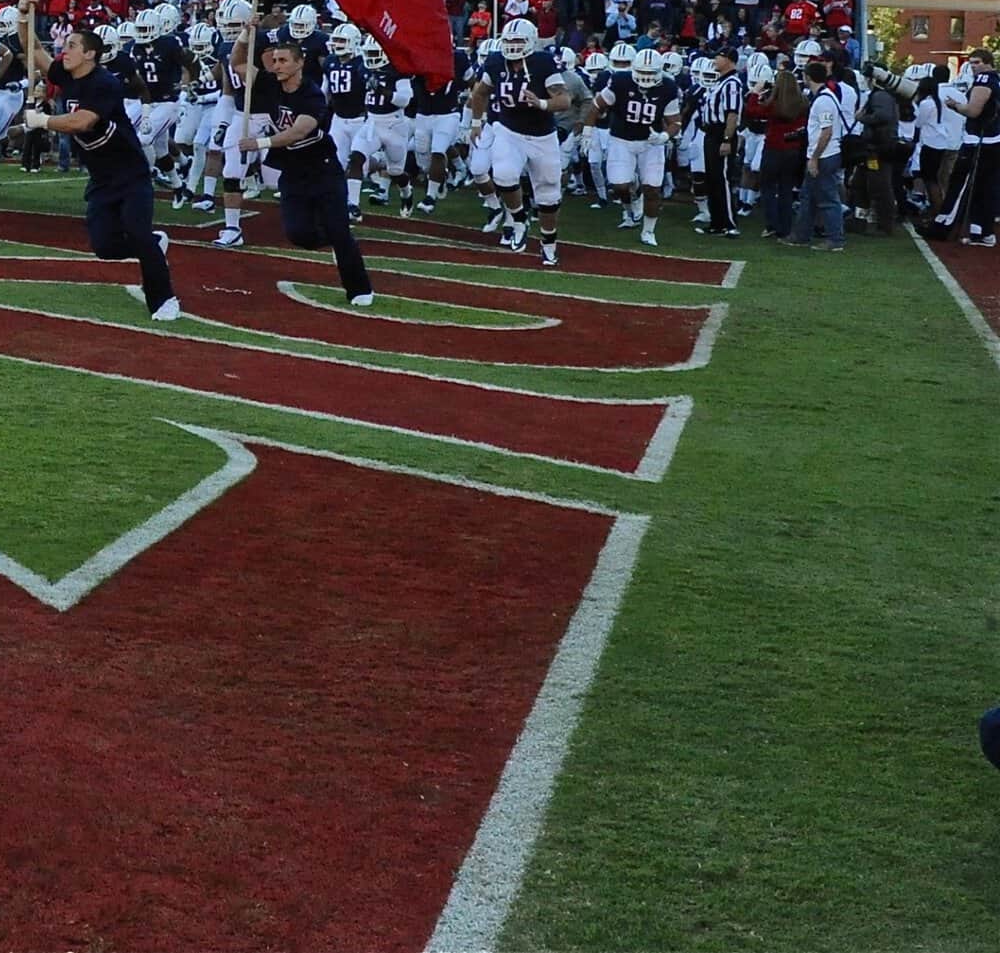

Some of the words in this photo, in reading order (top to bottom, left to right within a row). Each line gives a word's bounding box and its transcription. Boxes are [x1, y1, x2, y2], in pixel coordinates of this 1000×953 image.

[379, 11, 398, 40] TM
[143, 62, 159, 83] 2
[330, 70, 352, 94] 93
[626, 100, 657, 125] 99
